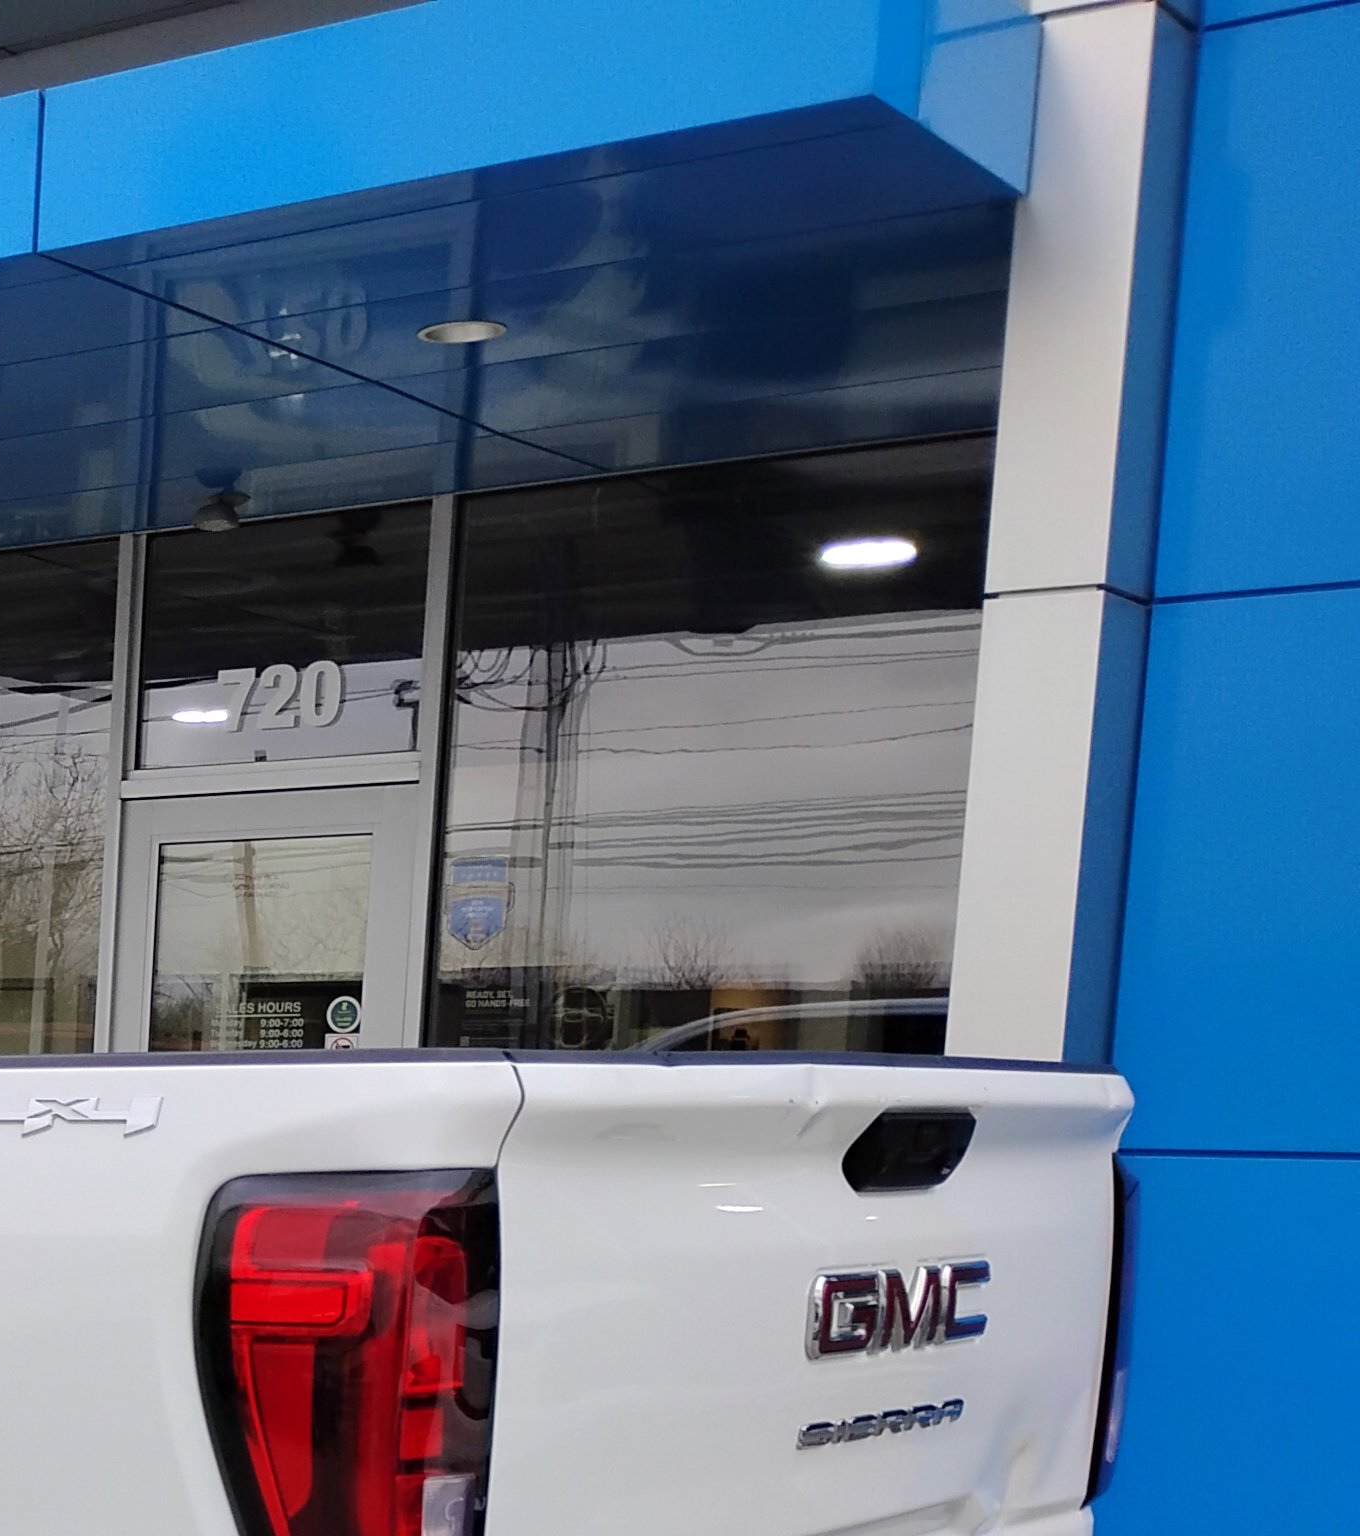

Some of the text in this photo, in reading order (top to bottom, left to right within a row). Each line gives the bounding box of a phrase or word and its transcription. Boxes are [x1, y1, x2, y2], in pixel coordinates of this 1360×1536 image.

[218, 660, 344, 733] 720
[211, 1019, 242, 1028] Mday
[258, 1002, 301, 1013] HOURS
[806, 1258, 991, 1361] GMC
[796, 1398, 964, 1450] SIERRA
